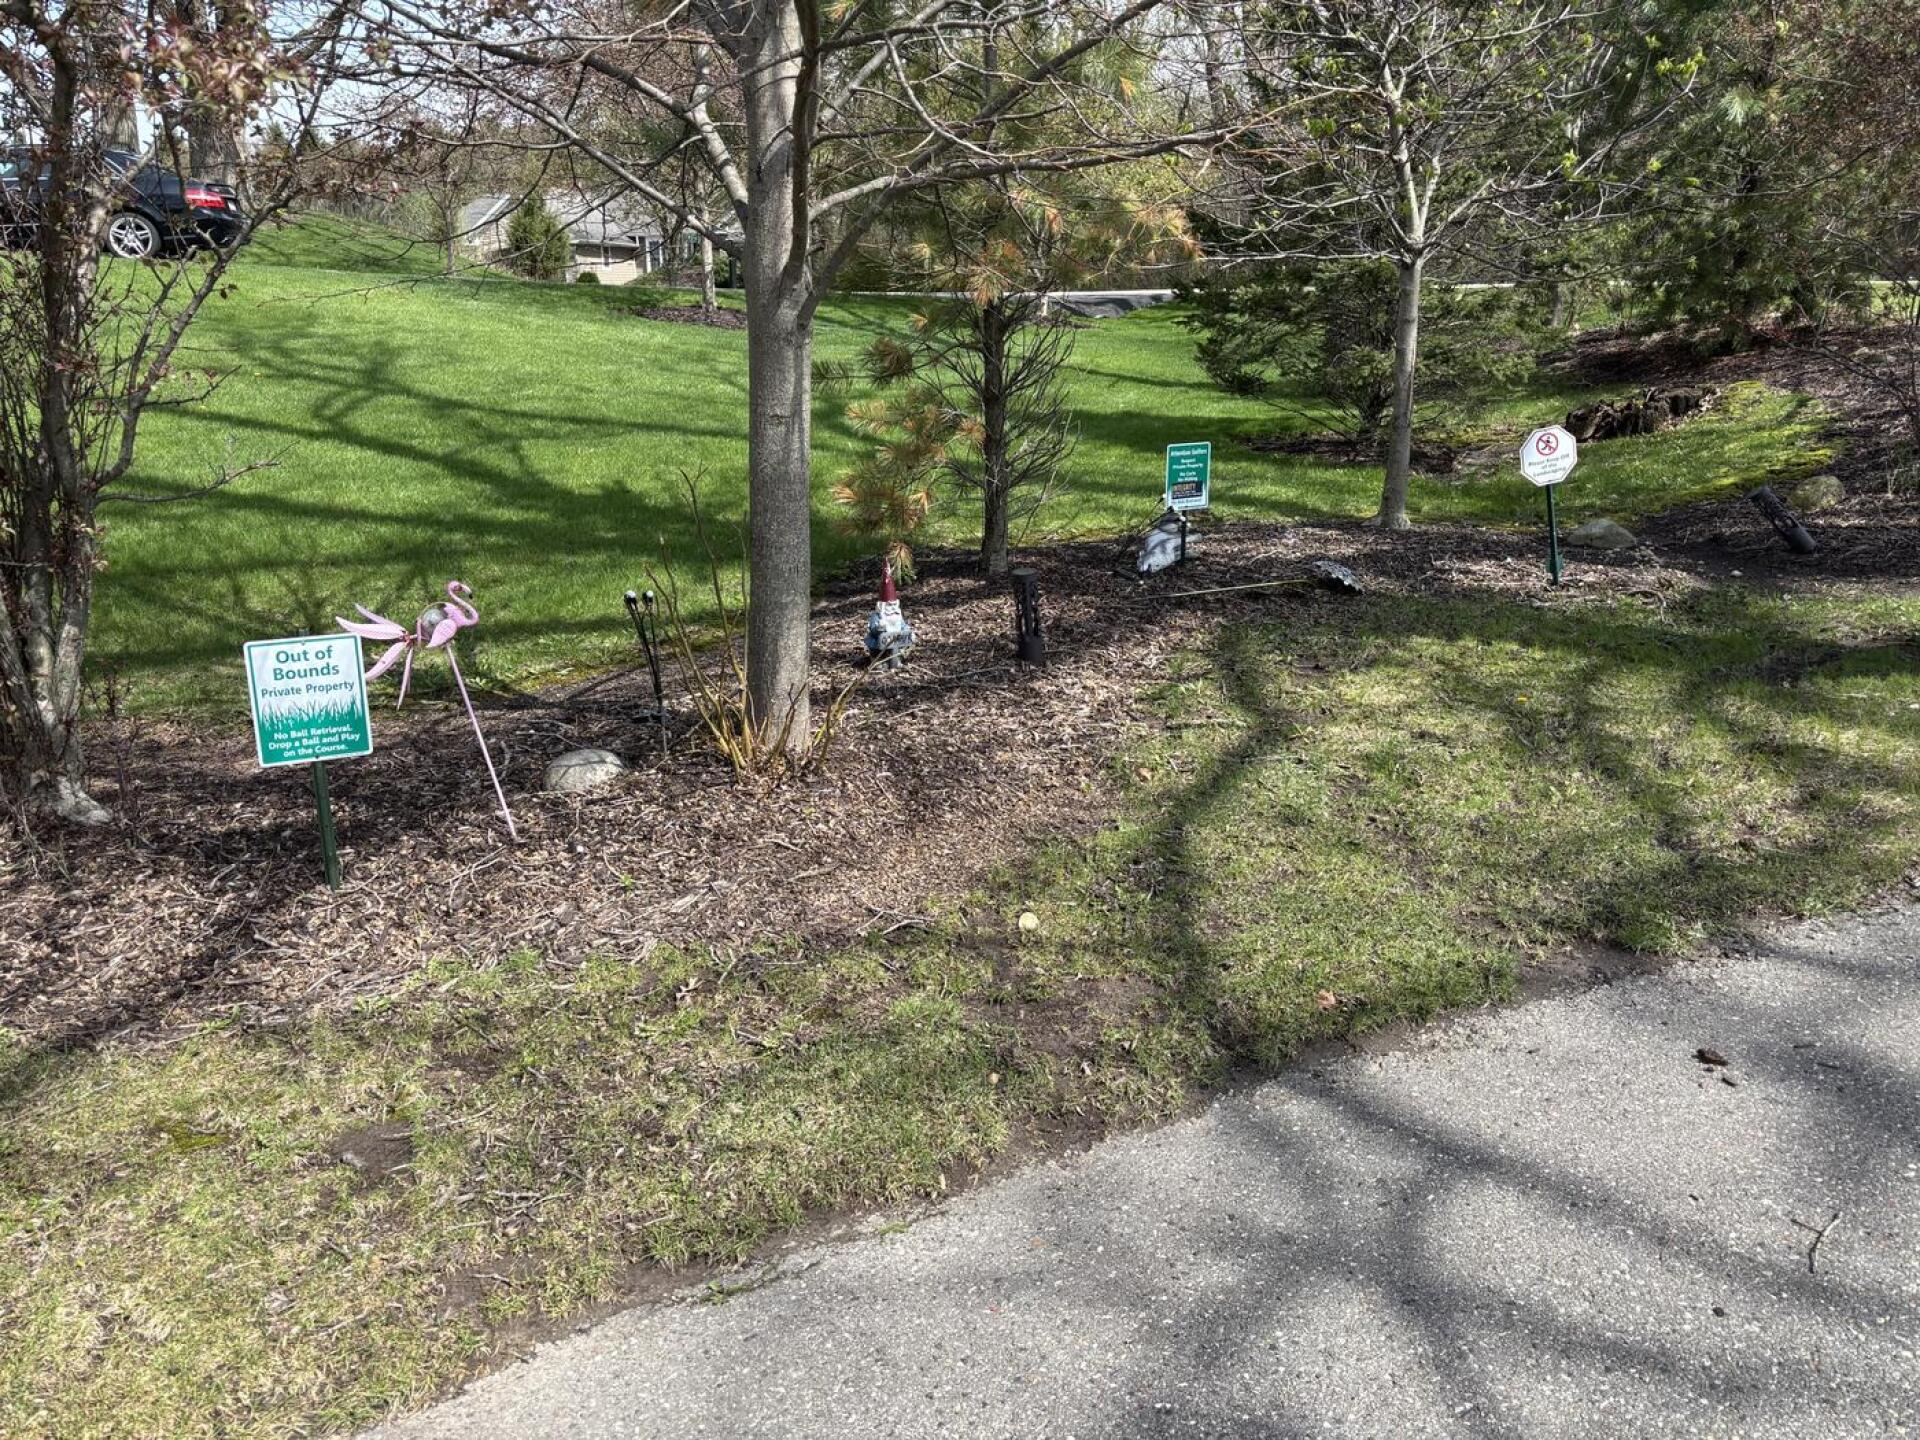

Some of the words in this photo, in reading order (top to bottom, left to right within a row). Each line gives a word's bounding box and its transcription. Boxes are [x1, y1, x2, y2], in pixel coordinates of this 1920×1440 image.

[275, 649, 310, 664] Out
[315, 645, 333, 660] of
[273, 662, 340, 681] Bounds
[261, 686, 302, 698] Private
[305, 681, 355, 695] Property
[274, 732, 288, 740] No
[290, 729, 308, 738] Ball
[311, 724, 353, 736] Retrieval.
[268, 740, 292, 750] Drop
[302, 737, 320, 746] Ball
[322, 735, 339, 743] and
[341, 732, 360, 741] Play
[283, 750, 296, 758] on
[298, 747, 313, 756] the
[315, 744, 348, 753] Course.
